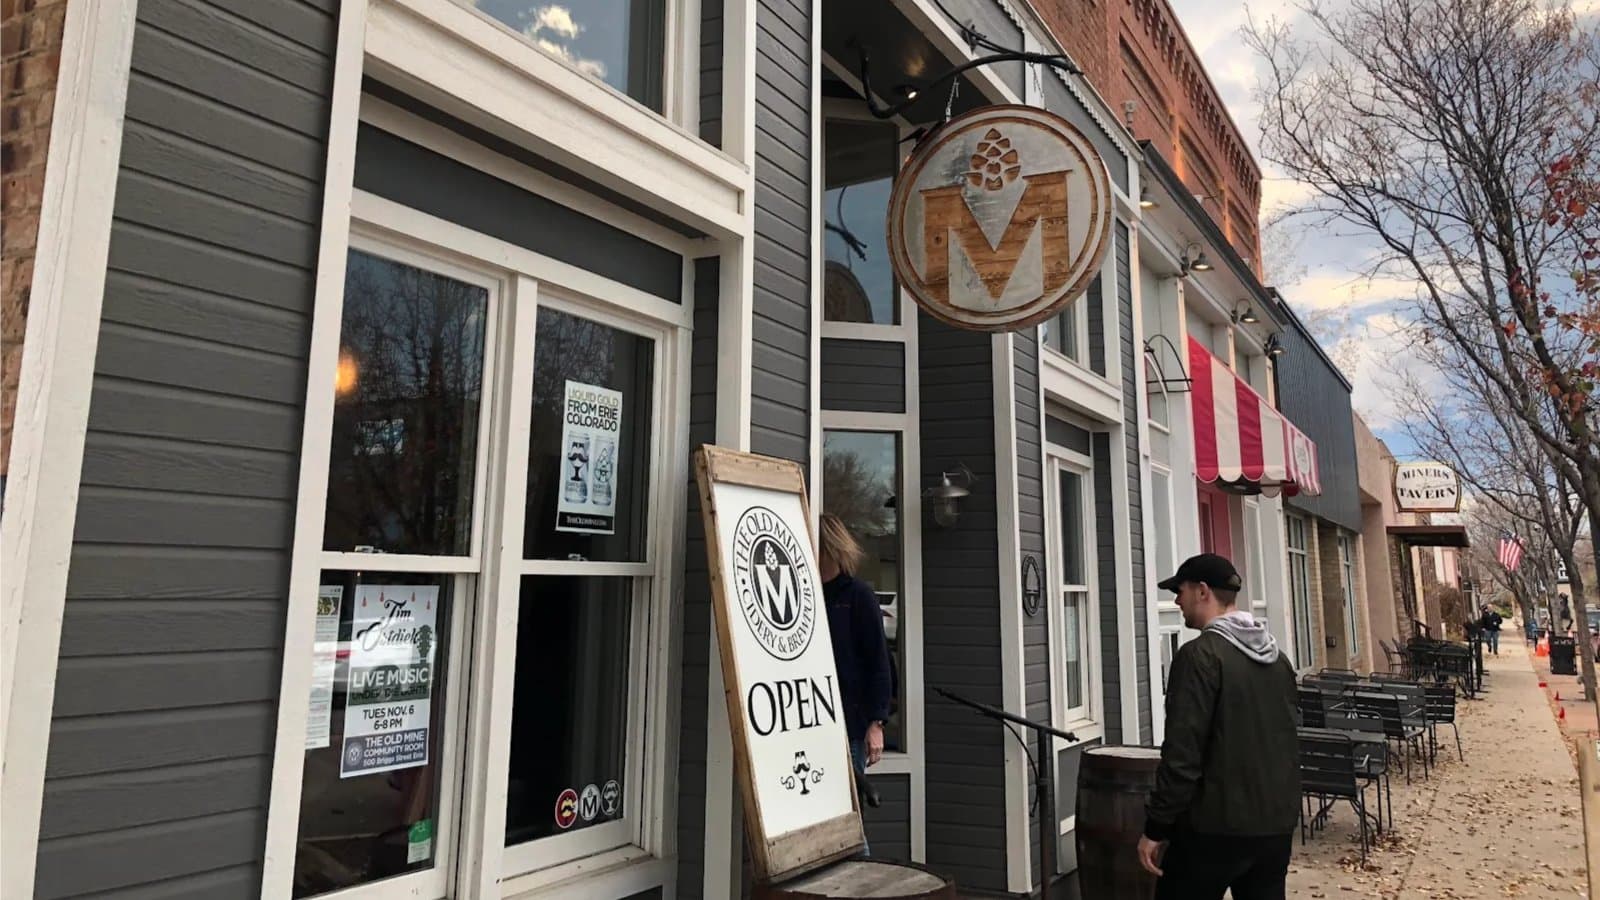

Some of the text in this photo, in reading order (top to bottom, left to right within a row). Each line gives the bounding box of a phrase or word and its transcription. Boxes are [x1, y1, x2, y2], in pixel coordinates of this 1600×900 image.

[919, 169, 1073, 306] M
[568, 389, 618, 408] LIQUID GOLD
[568, 399, 618, 420] FROM ERIE
[567, 412, 617, 432] COLORADO
[1398, 487, 1455, 499] TAVERN
[736, 512, 808, 576] THE OLD MINE
[383, 599, 412, 622] Tim
[742, 587, 778, 649] CIDERY
[788, 587, 813, 652] BREWPUB
[352, 667, 429, 688] LIVE MUSIC
[363, 704, 415, 720] TUES NOV. 6
[747, 675, 837, 736] OPEN
[374, 718, 403, 730] 6-8 PM
[365, 731, 425, 748] THE OLD MINE
[363, 742, 424, 758] COMMUNITY ROOM
